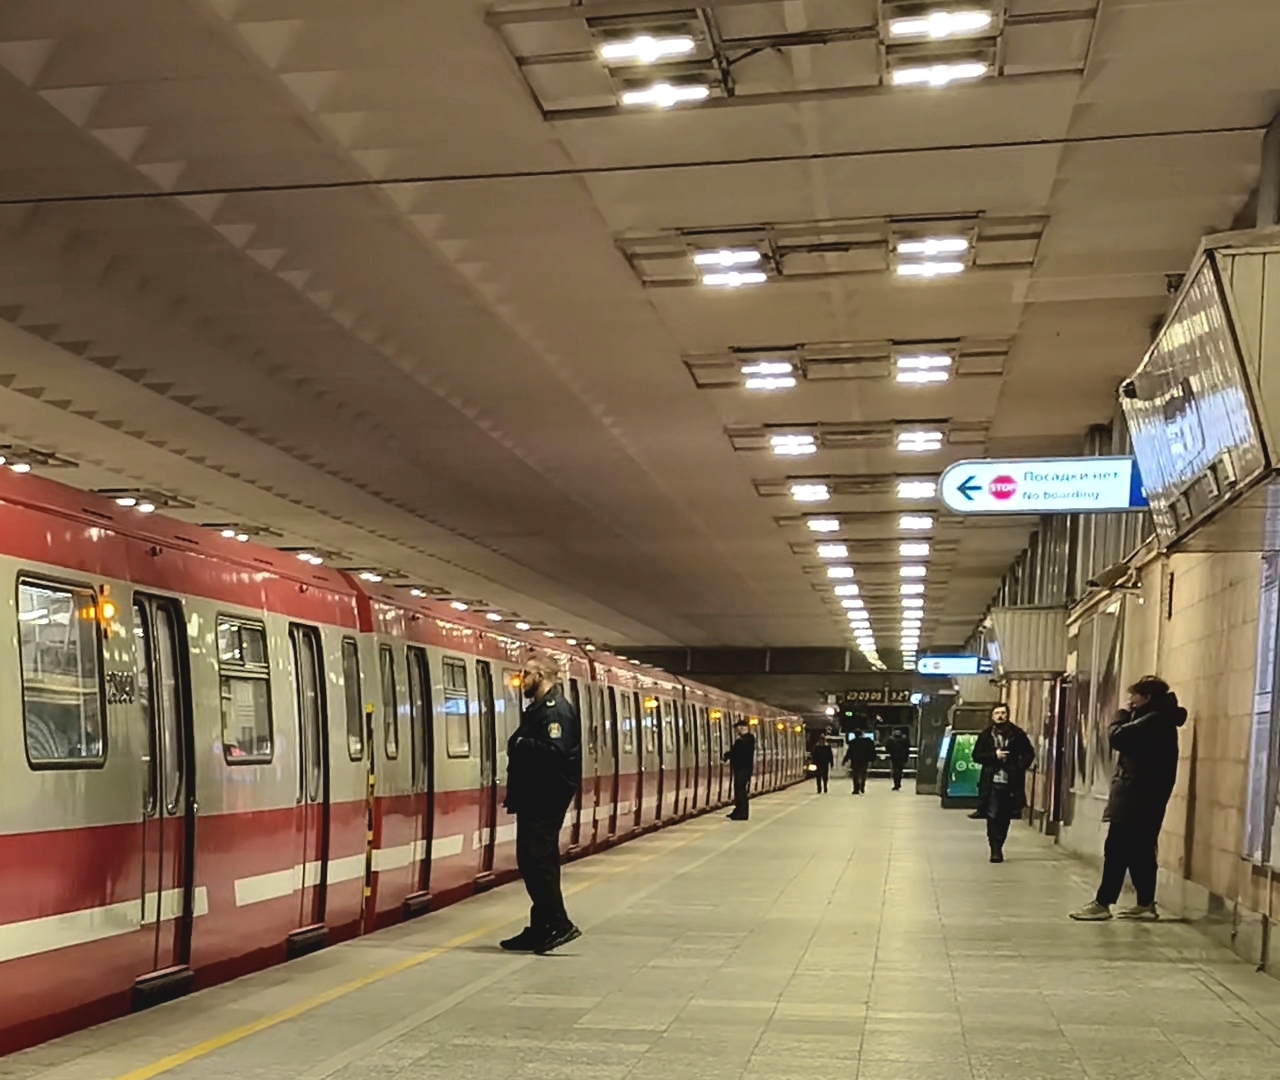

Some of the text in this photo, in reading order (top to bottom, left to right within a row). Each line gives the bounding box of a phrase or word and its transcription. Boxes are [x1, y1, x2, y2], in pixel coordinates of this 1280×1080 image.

[1023, 471, 1119, 482] Посадки нет
[990, 483, 1018, 492] STOP
[1022, 491, 1040, 500] No
